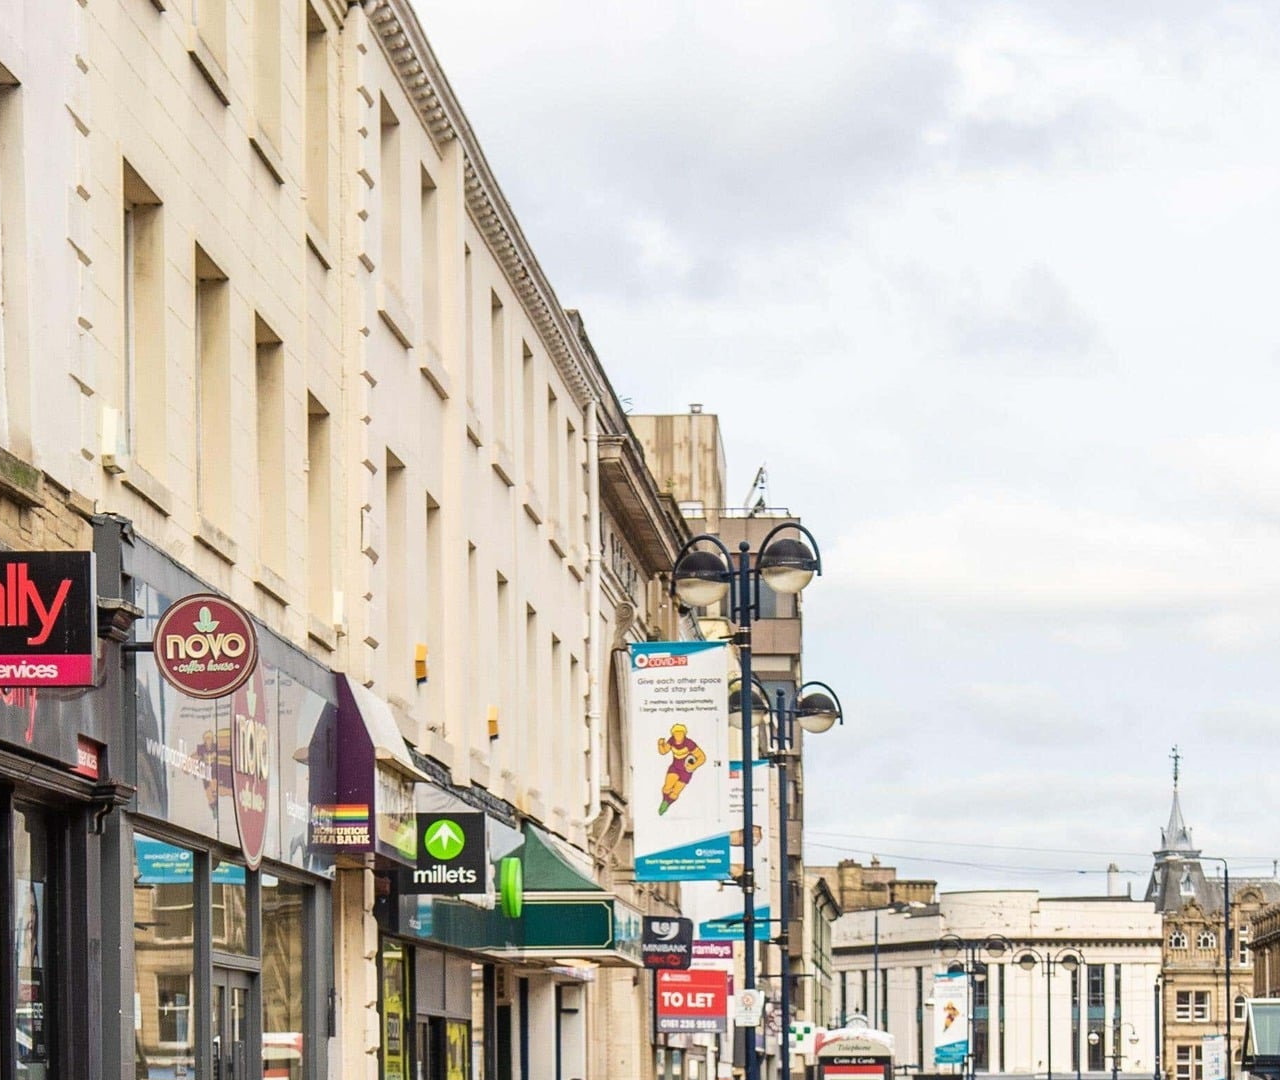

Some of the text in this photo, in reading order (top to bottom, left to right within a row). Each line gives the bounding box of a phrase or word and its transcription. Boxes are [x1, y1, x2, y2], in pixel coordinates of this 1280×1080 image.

[166, 632, 245, 660] novo
[179, 658, 235, 674] coffee house
[672, 686, 687, 694] stay
[413, 864, 477, 884] millets
[642, 943, 688, 953] MINIBANK
[661, 991, 715, 1008] TO LET
